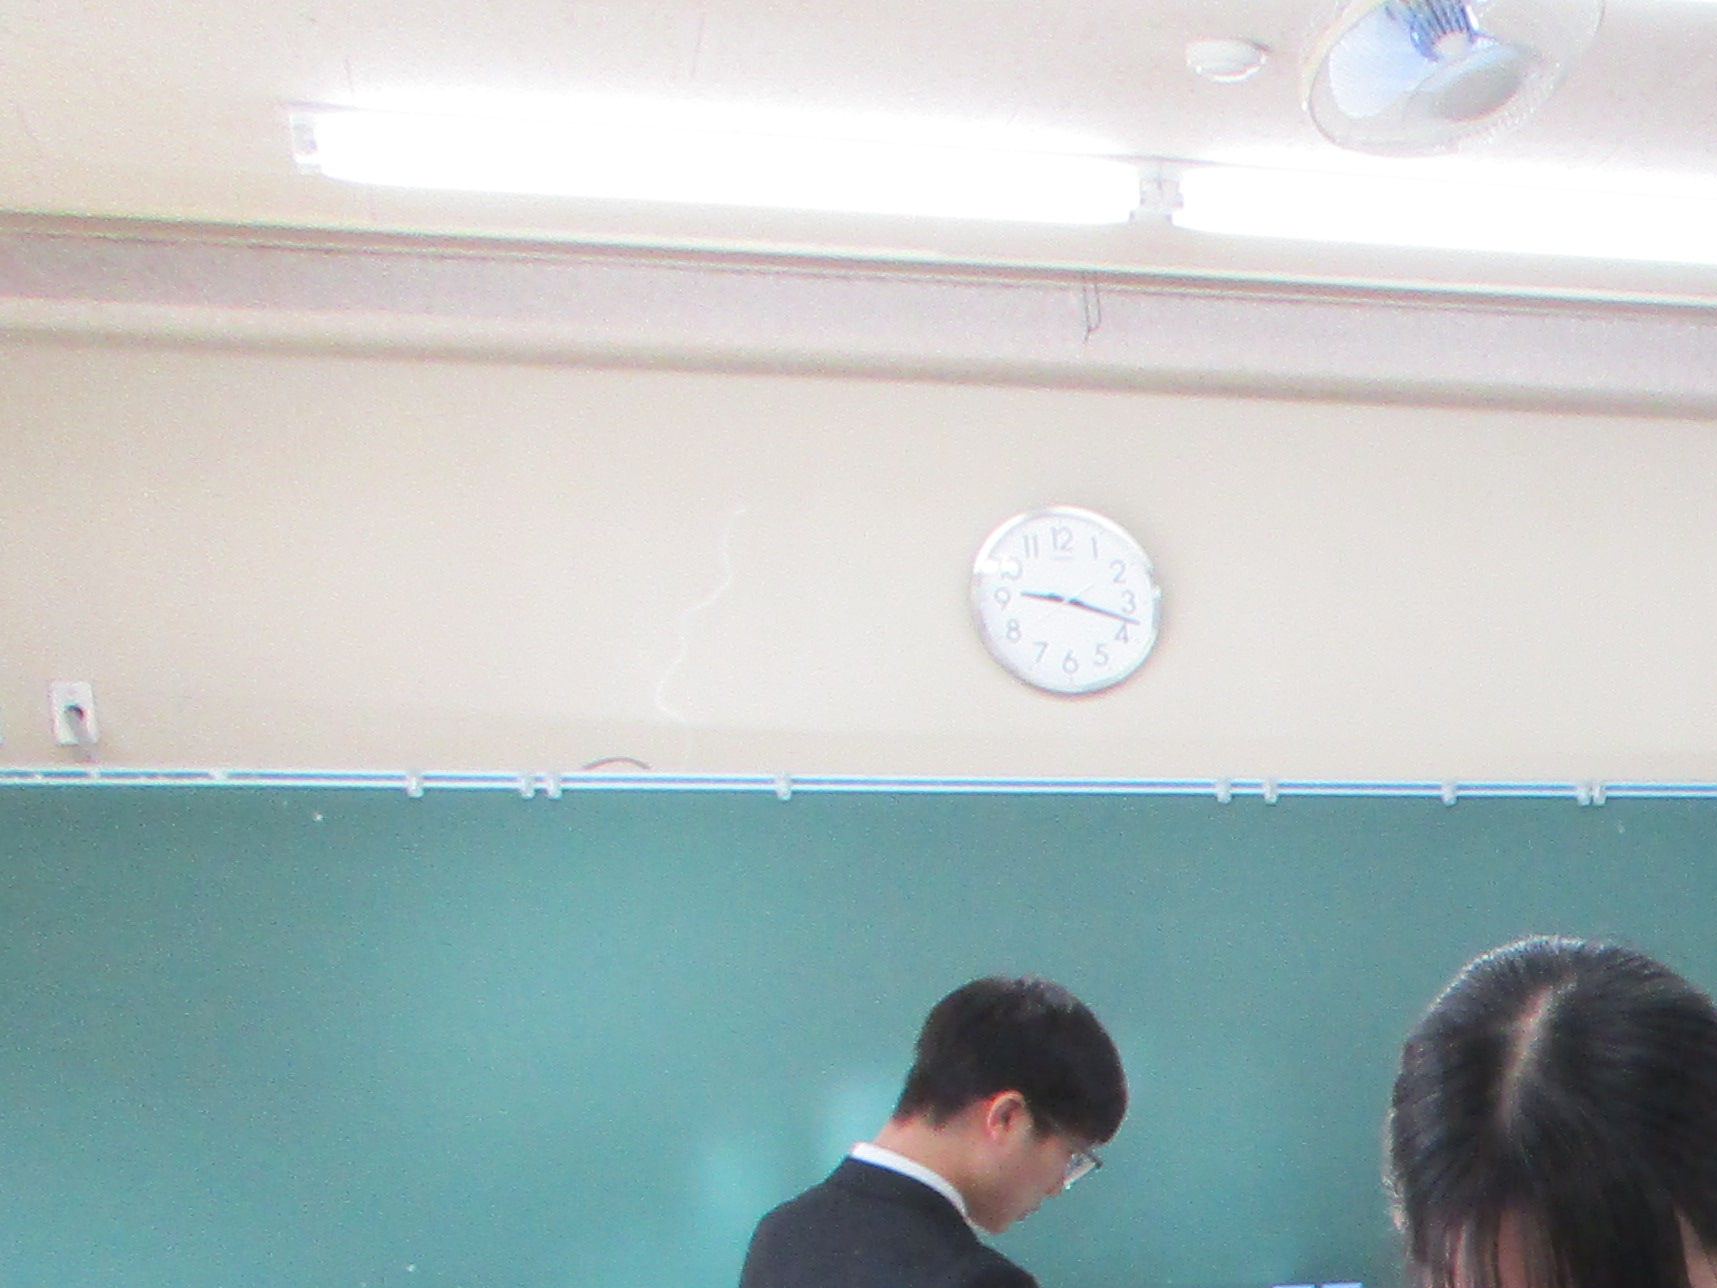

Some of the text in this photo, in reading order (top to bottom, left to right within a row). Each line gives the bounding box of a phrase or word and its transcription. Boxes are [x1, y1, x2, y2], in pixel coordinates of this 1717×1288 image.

[1023, 534, 1039, 559] 11
[1051, 526, 1073, 551] 12
[1110, 559, 1126, 583] 2
[994, 586, 1011, 611] 9
[1120, 589, 1136, 613] 3
[1006, 618, 1022, 643] 8
[1114, 620, 1130, 644] 4
[1034, 641, 1049, 664] 7
[1062, 650, 1079, 674] 6
[1093, 643, 1110, 666] 5
